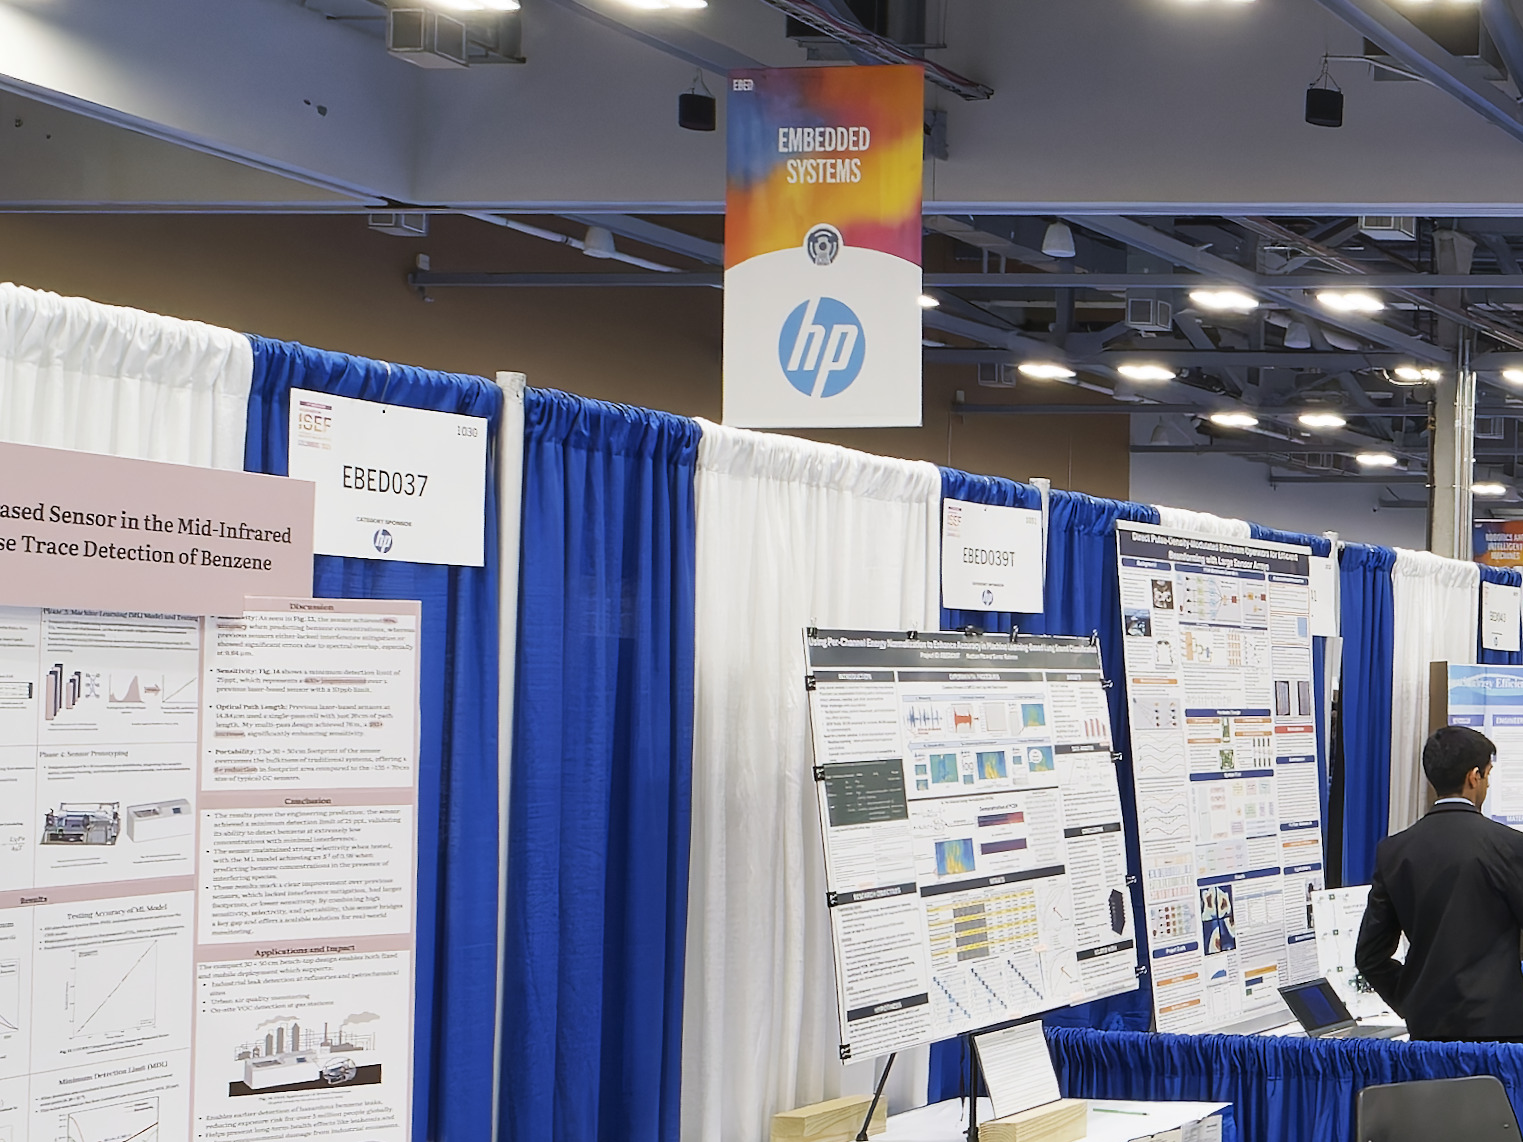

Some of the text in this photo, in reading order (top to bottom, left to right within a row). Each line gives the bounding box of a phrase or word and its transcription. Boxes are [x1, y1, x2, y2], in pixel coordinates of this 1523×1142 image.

[733, 79, 753, 91] EBED
[778, 126, 871, 153] EMBEDDED
[786, 158, 862, 184] SYSTEMS
[786, 296, 859, 399] hp
[299, 413, 332, 433] ISEF
[457, 425, 478, 438] 1030
[343, 465, 428, 497] EBED037
[49, 505, 117, 528] Sensor
[120, 510, 140, 530] in
[144, 513, 174, 533] the
[177, 517, 292, 544] Mid-Infrared
[373, 528, 393, 553] hp
[21, 535, 79, 557] Trace
[83, 540, 175, 564] Detection
[178, 547, 199, 565] of
[201, 550, 272, 571] Benzene
[963, 547, 1015, 567] EBED039T
[289, 603, 334, 611] Discussion
[284, 797, 332, 805] Conclusion
[254, 947, 308, 957] Applications
